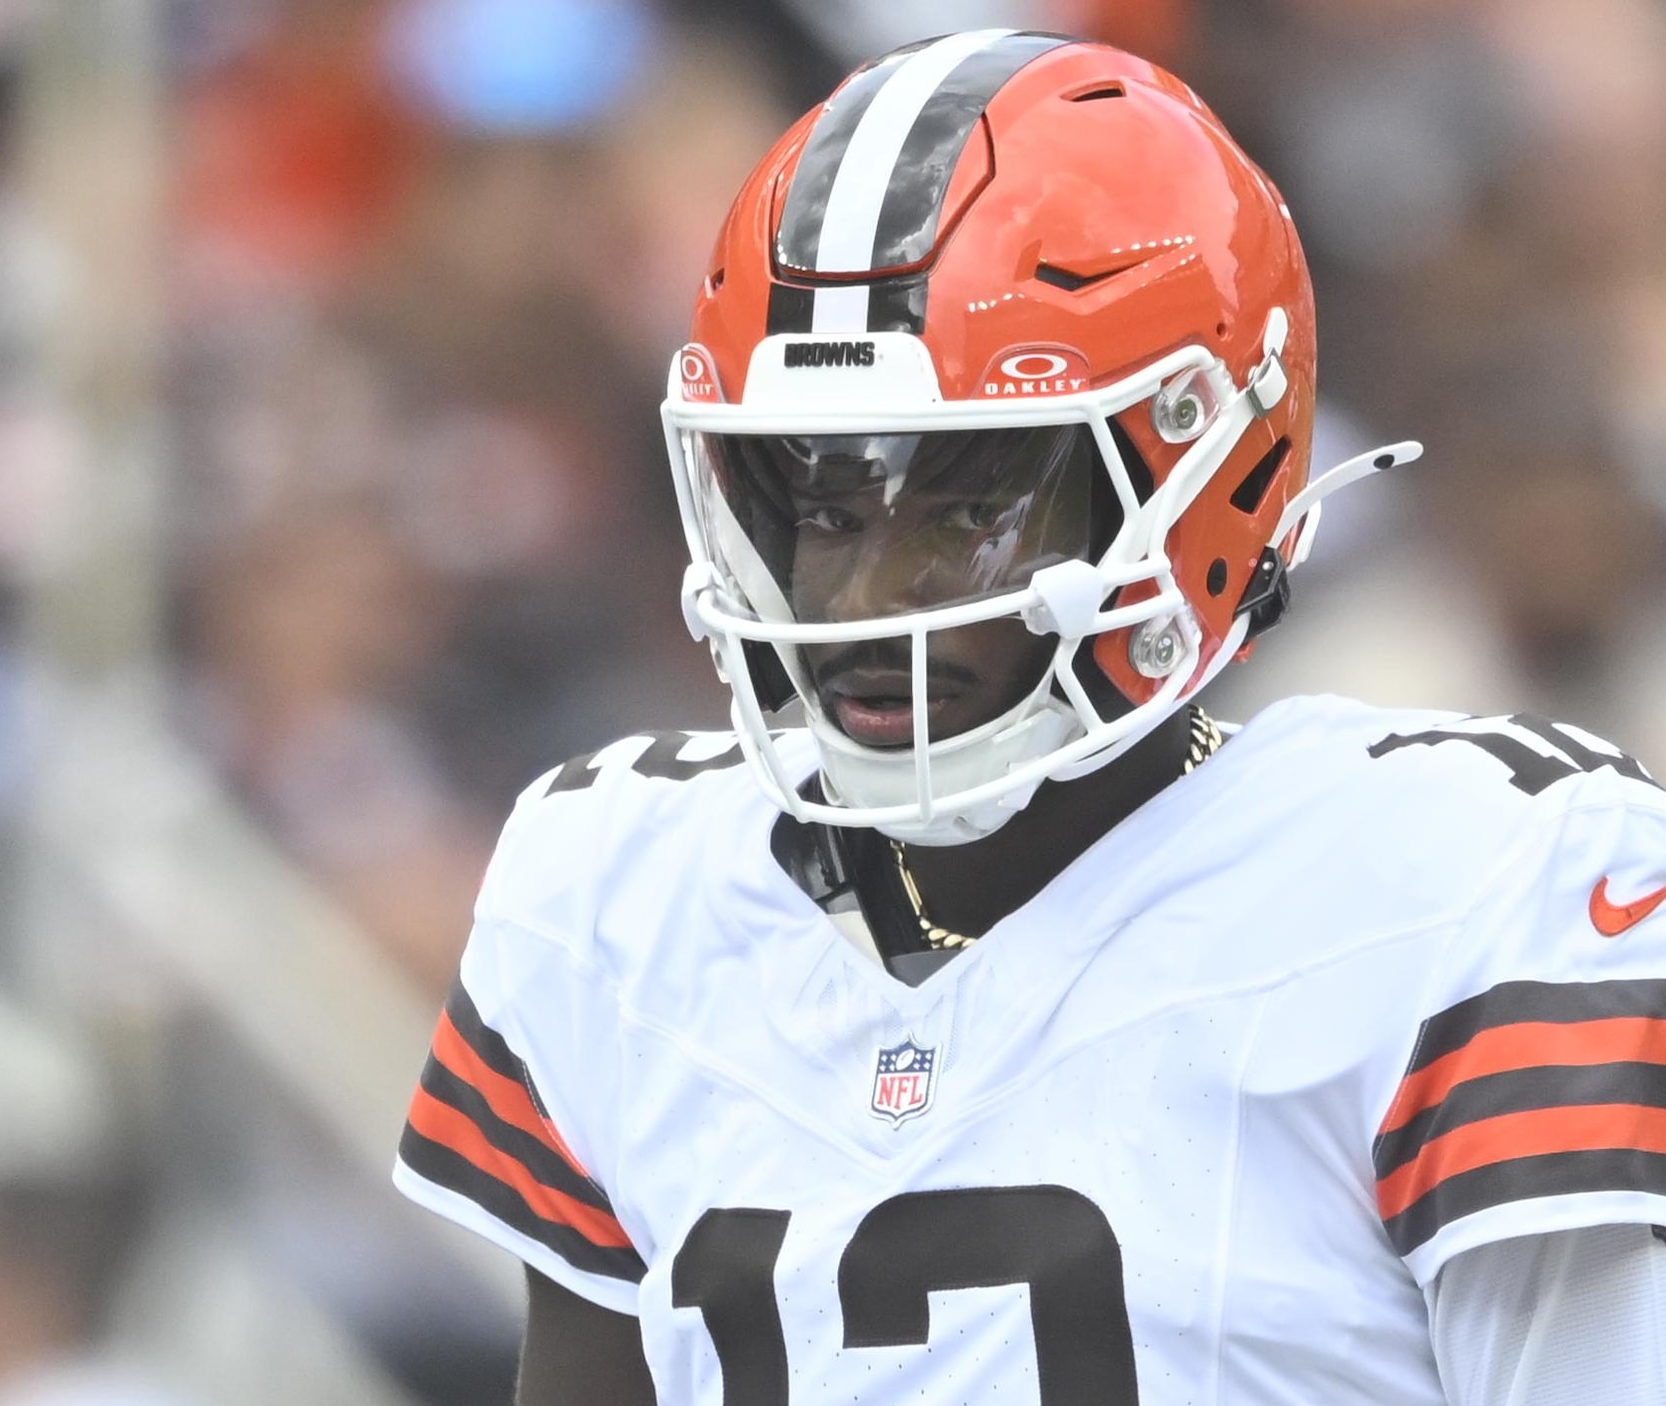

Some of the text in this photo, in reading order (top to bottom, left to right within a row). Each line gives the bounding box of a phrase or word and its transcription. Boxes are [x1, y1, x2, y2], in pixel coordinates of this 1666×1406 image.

[784, 341, 875, 367] BROWNS
[984, 378, 1082, 395] OAKLEY
[876, 1075, 923, 1110] NFL
